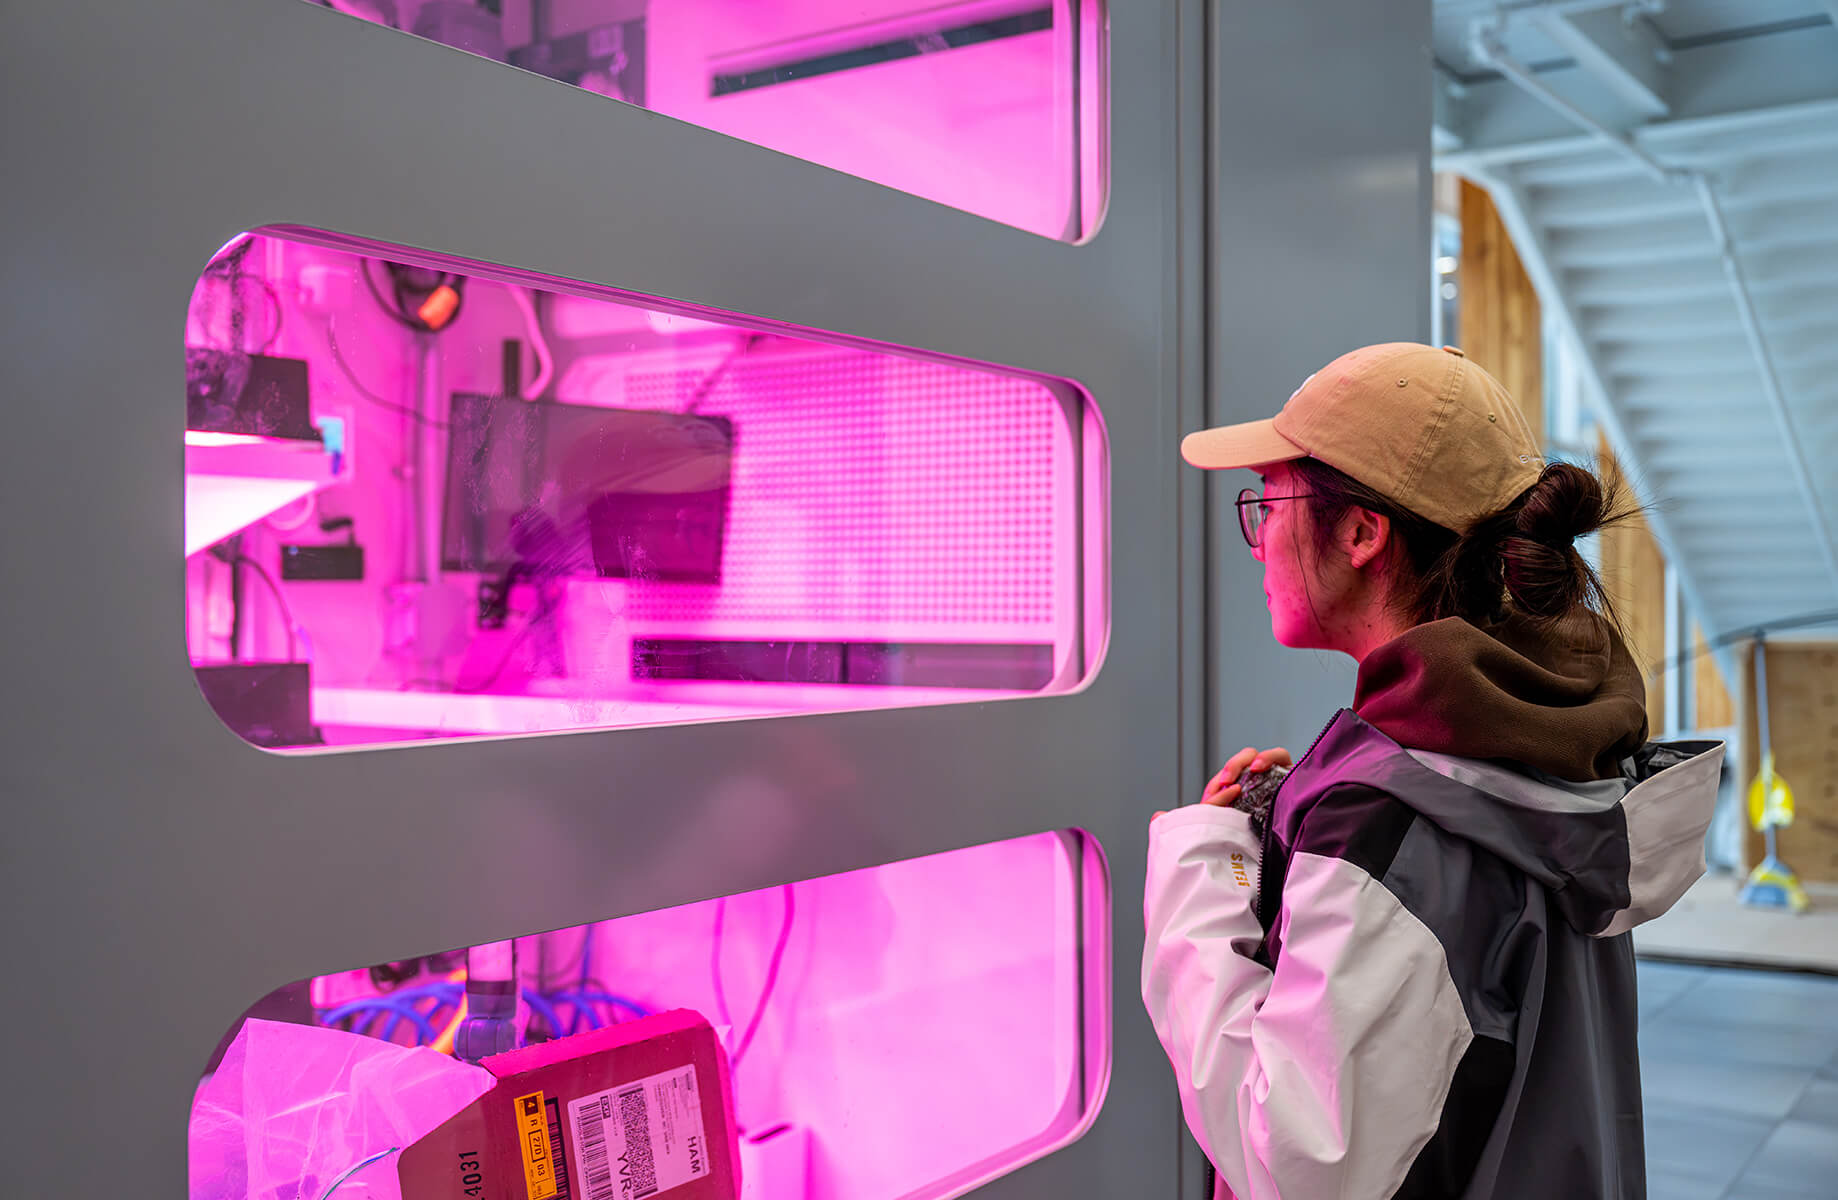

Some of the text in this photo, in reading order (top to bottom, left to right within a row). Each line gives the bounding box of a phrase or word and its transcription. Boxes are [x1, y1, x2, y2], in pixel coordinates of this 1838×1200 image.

[530, 1119, 538, 1127] R
[537, 1163, 546, 1176] 03
[688, 1136, 701, 1173] HAM
[458, 1151, 485, 1200] 4031
[617, 1151, 631, 1192] YVR
